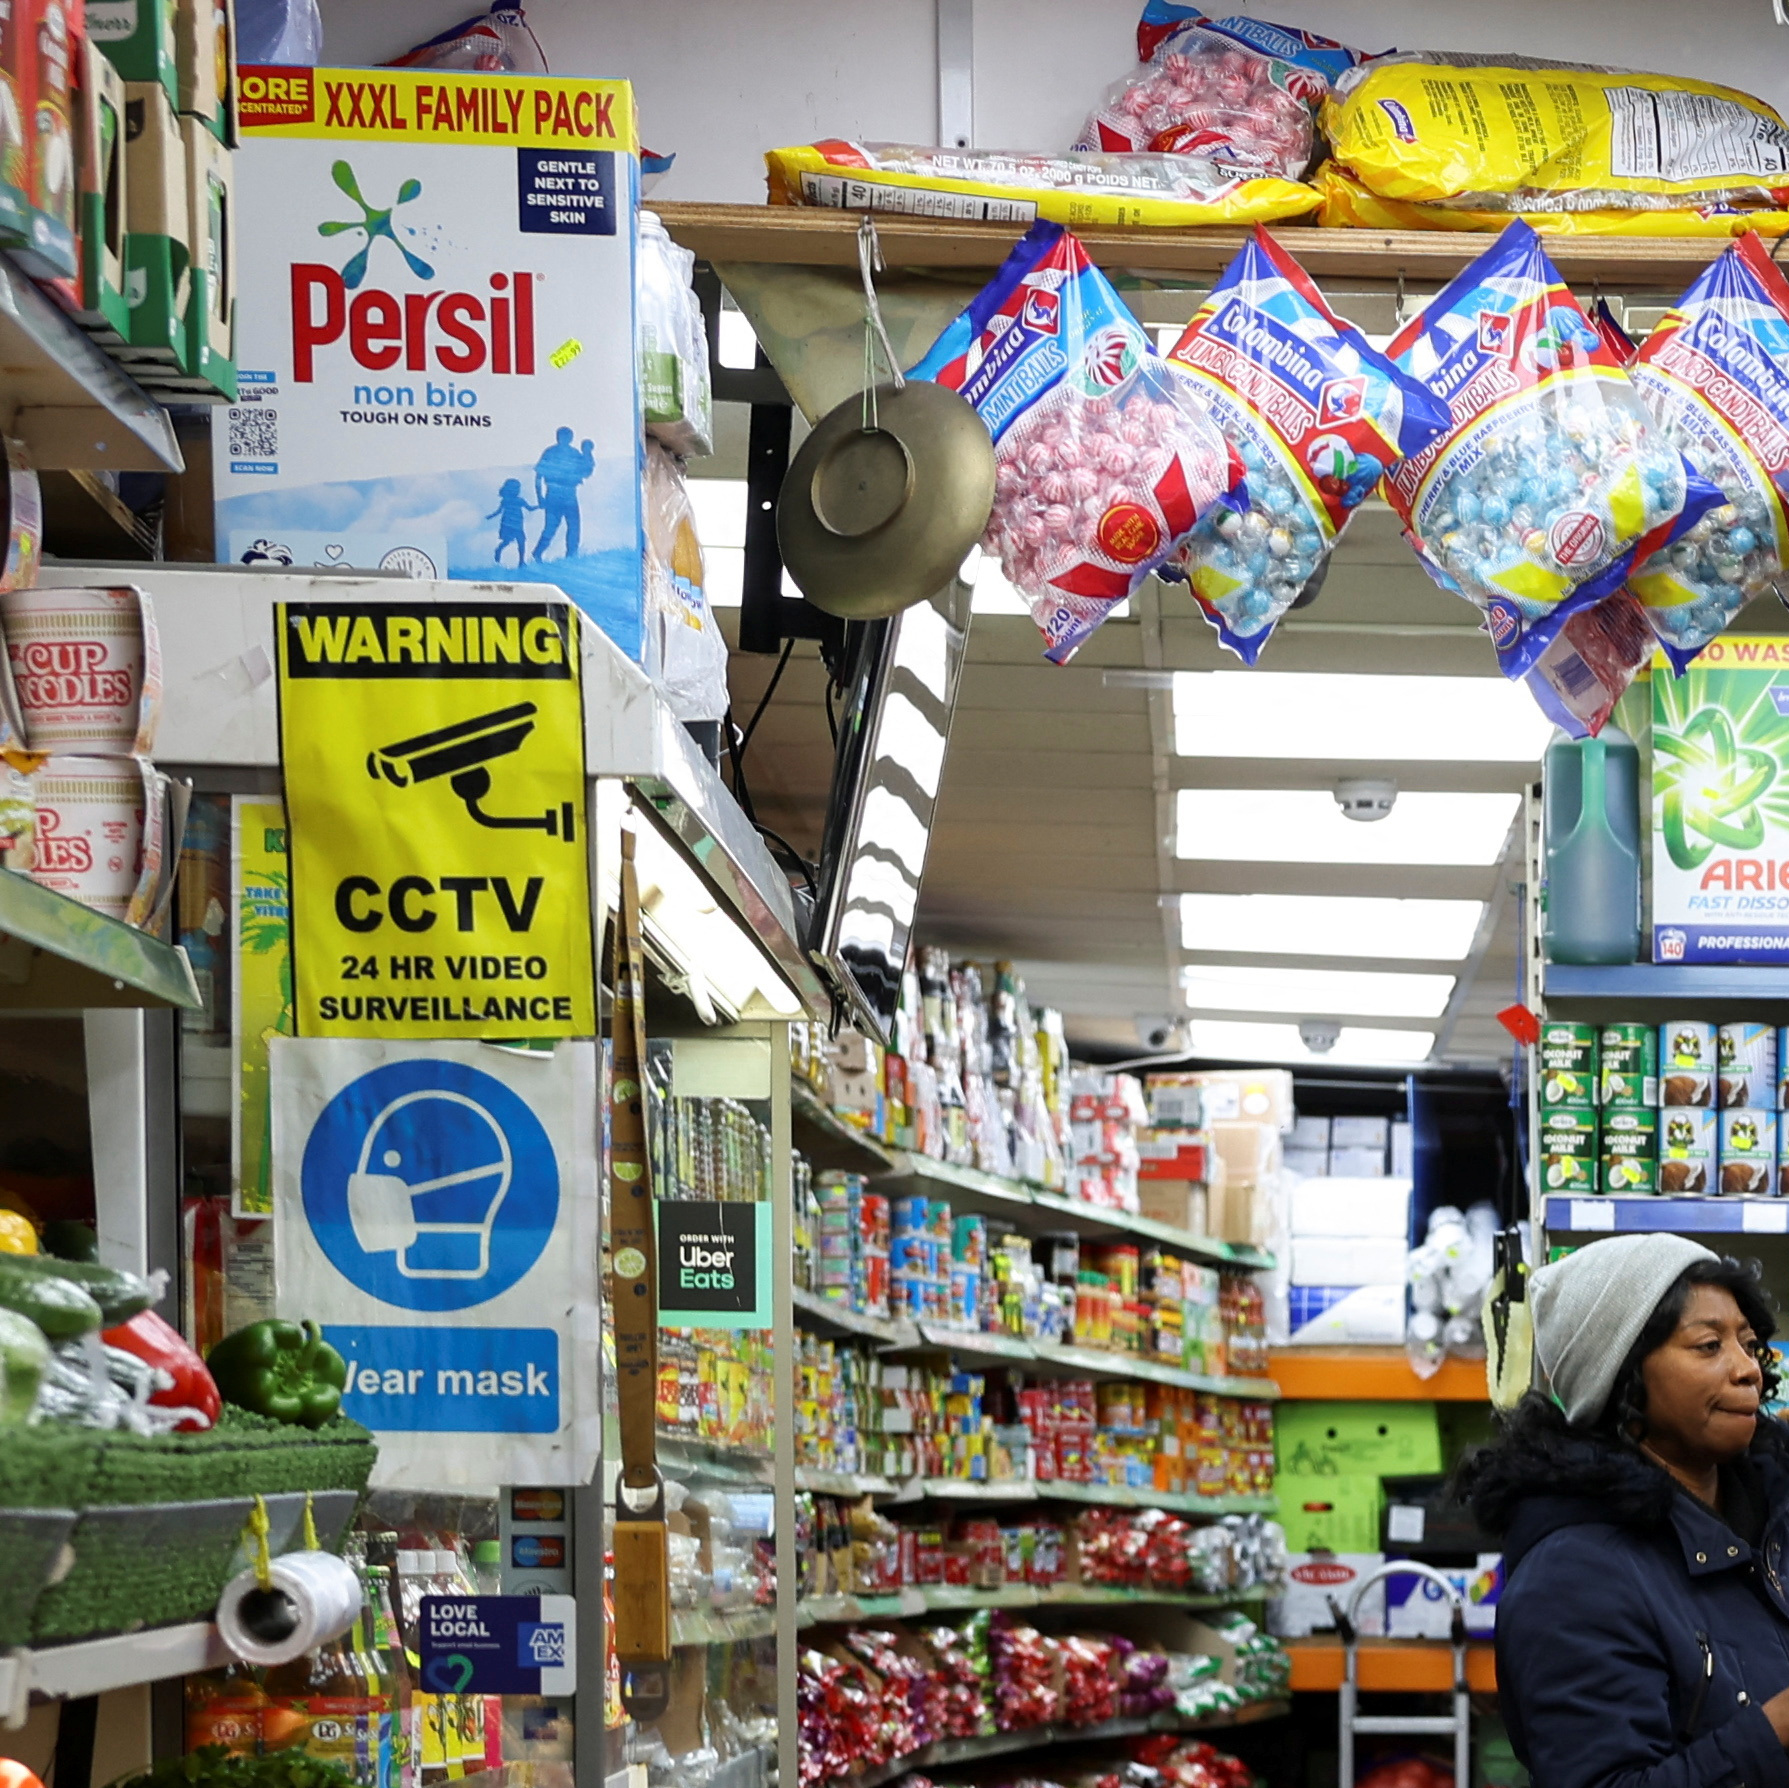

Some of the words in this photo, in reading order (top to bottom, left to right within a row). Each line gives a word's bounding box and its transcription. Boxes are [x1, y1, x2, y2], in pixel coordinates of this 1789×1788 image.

[1245, 21, 1304, 59] BALLS
[323, 81, 408, 129] XXXL
[415, 85, 526, 134] FAMILY
[534, 90, 618, 139] PACK
[537, 160, 597, 175] GENTLE
[932, 154, 960, 169] NET
[1040, 167, 1073, 184] 2000
[1085, 172, 1128, 188] POIDS
[534, 177, 576, 191] NEXT
[578, 178, 601, 191] TO
[526, 193, 606, 208] SENSITIVE
[549, 210, 587, 225] SKIN
[290, 262, 536, 383] Persil
[1177, 338, 1231, 377] JUMBO
[1222, 303, 1320, 392] Colombina
[1014, 337, 1068, 395] BALLS
[354, 384, 415, 407] non
[425, 382, 479, 408] bio
[339, 410, 393, 426] TOUGH
[402, 412, 430, 427] ON
[432, 413, 493, 428] STAINS
[298, 616, 564, 664] WARNING
[24, 641, 109, 674] CUP
[334, 875, 544, 933] CCTV
[1686, 895, 1733, 911] FAST
[1662, 941, 1683, 956] 140
[340, 956, 380, 981] 24
[390, 956, 436, 981] HR
[444, 955, 548, 981] VIDEO
[318, 995, 573, 1022] SURVEILLANCE
[678, 1234, 710, 1243] ORDER
[710, 1234, 735, 1243] WITH
[678, 1245, 735, 1268] Uber
[679, 1268, 735, 1290] Eats
[436, 1362, 551, 1397] mask
[430, 1604, 479, 1621] LOVE
[430, 1623, 491, 1638] LOCAL
[530, 1629, 566, 1646] AM
[533, 1645, 566, 1663] EX
